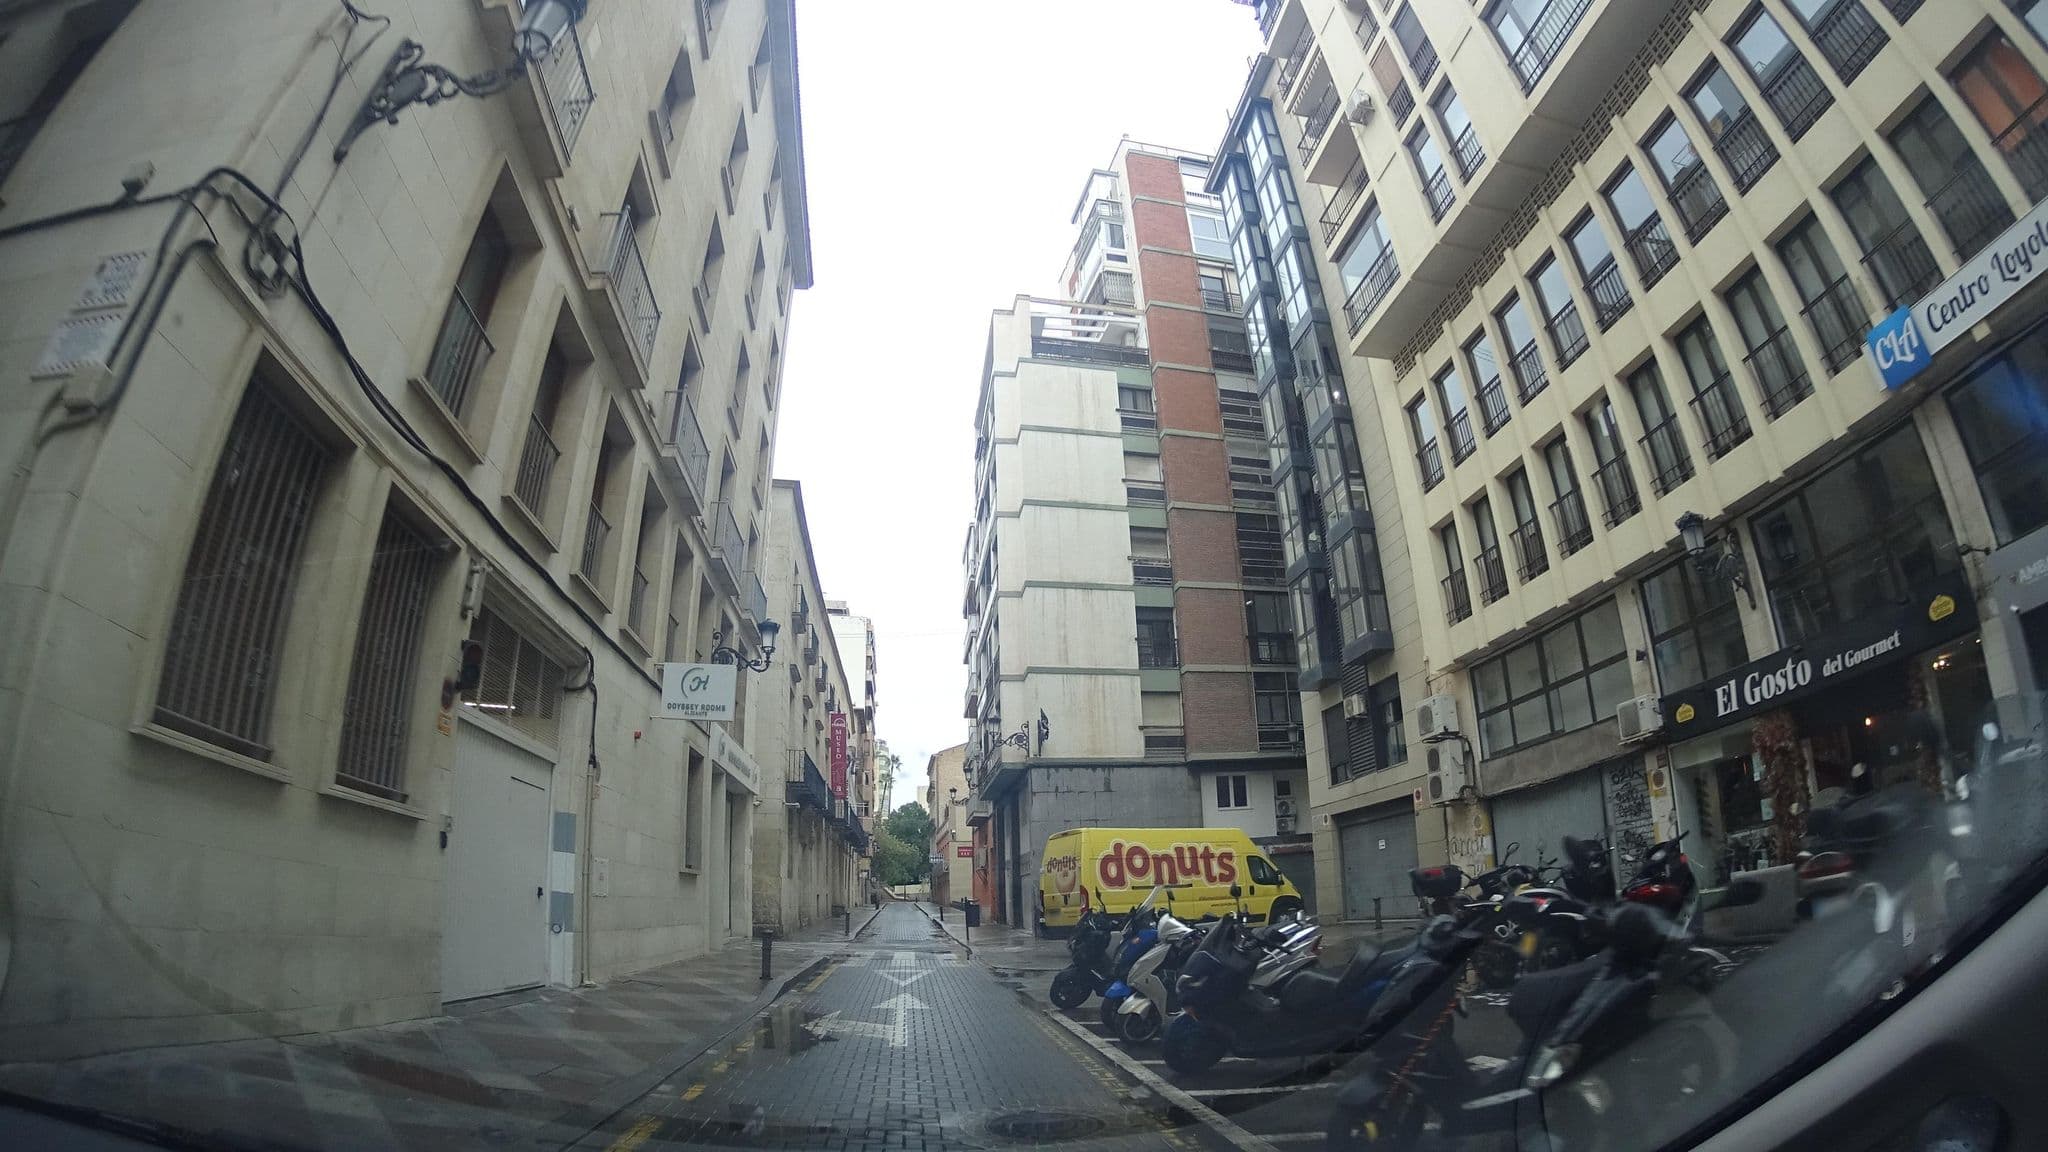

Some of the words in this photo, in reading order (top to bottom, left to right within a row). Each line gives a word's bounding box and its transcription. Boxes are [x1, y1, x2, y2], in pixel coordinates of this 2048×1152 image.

[1875, 316, 1919, 370] CLA
[1926, 274, 1991, 333] Centro
[1990, 220, 2048, 283] Loyol
[1715, 679, 1740, 718] El
[1743, 657, 1812, 706] Gosto
[1822, 654, 1843, 678] del
[1844, 630, 1902, 668] Gourmet
[667, 702, 699, 711] ODYSSEY
[700, 704, 726, 712] ROOMS
[1046, 854, 1078, 874] donuts
[1100, 842, 1237, 888] donuts
